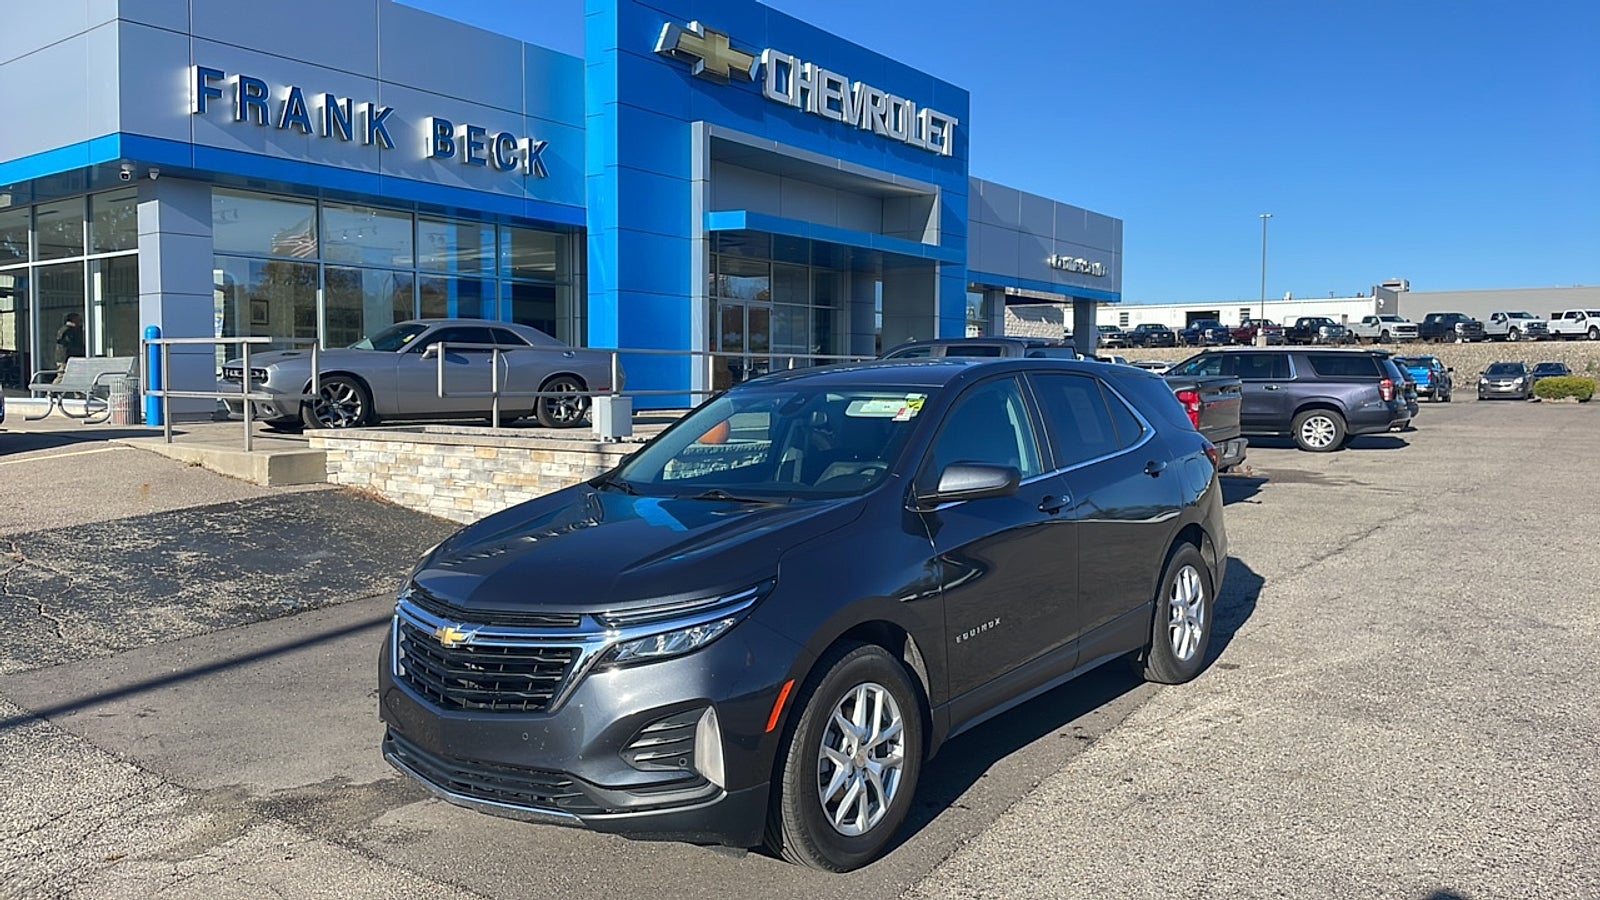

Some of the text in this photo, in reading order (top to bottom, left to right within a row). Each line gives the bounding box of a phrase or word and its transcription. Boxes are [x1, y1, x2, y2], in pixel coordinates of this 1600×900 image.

[191, 65, 549, 178] FRANK BECK
[761, 48, 958, 157] CHEVROLET
[955, 617, 1001, 644] EQUINOX
